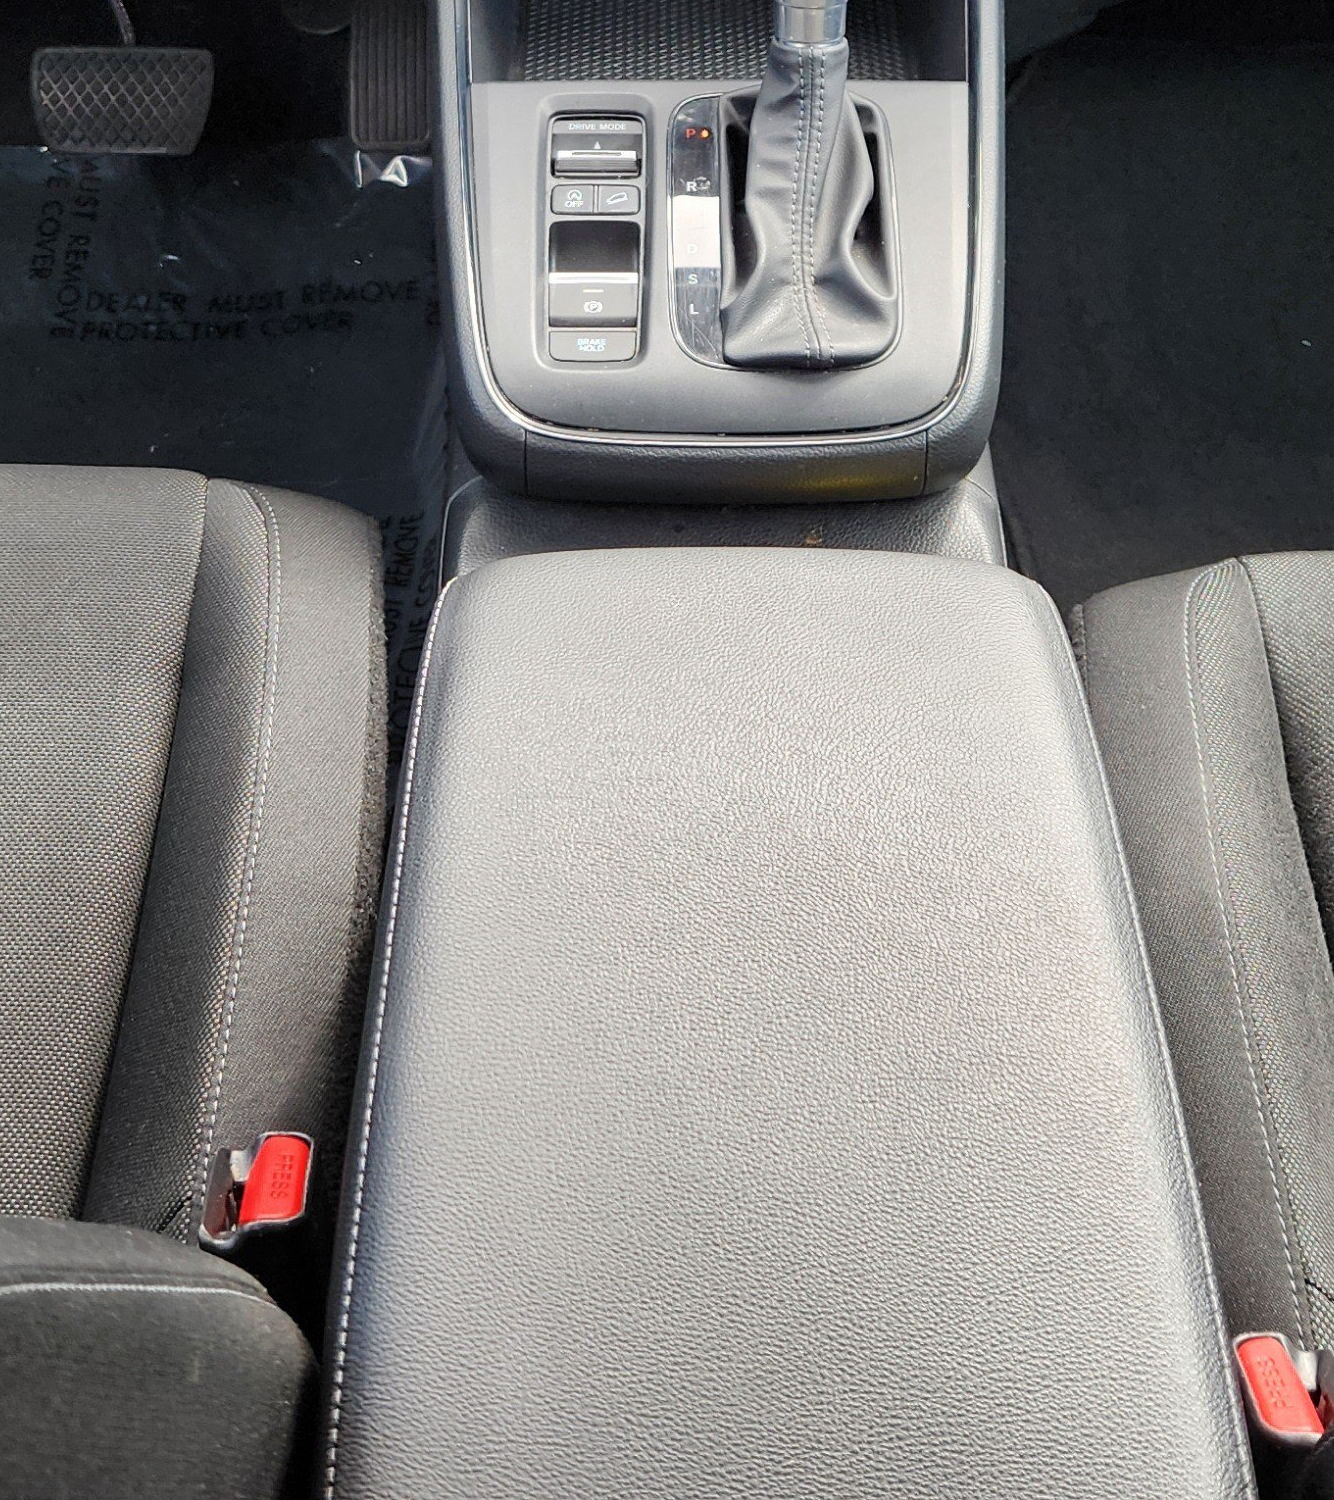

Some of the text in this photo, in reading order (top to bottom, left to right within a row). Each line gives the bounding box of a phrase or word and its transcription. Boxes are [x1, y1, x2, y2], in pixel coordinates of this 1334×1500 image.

[568, 123, 627, 131] DRIVE MODE
[685, 128, 696, 139] P
[686, 180, 697, 192] R
[564, 200, 584, 208] OFF
[28, 201, 65, 280] COVER
[687, 243, 697, 254] D
[688, 273, 698, 285] S
[301, 278, 421, 306] REMOVE
[690, 303, 699, 315] L
[577, 338, 607, 346] BRAKE
[578, 344, 605, 352] HOLD
[270, 1154, 294, 1199] PRESS
[1256, 1356, 1294, 1409] PRESS
